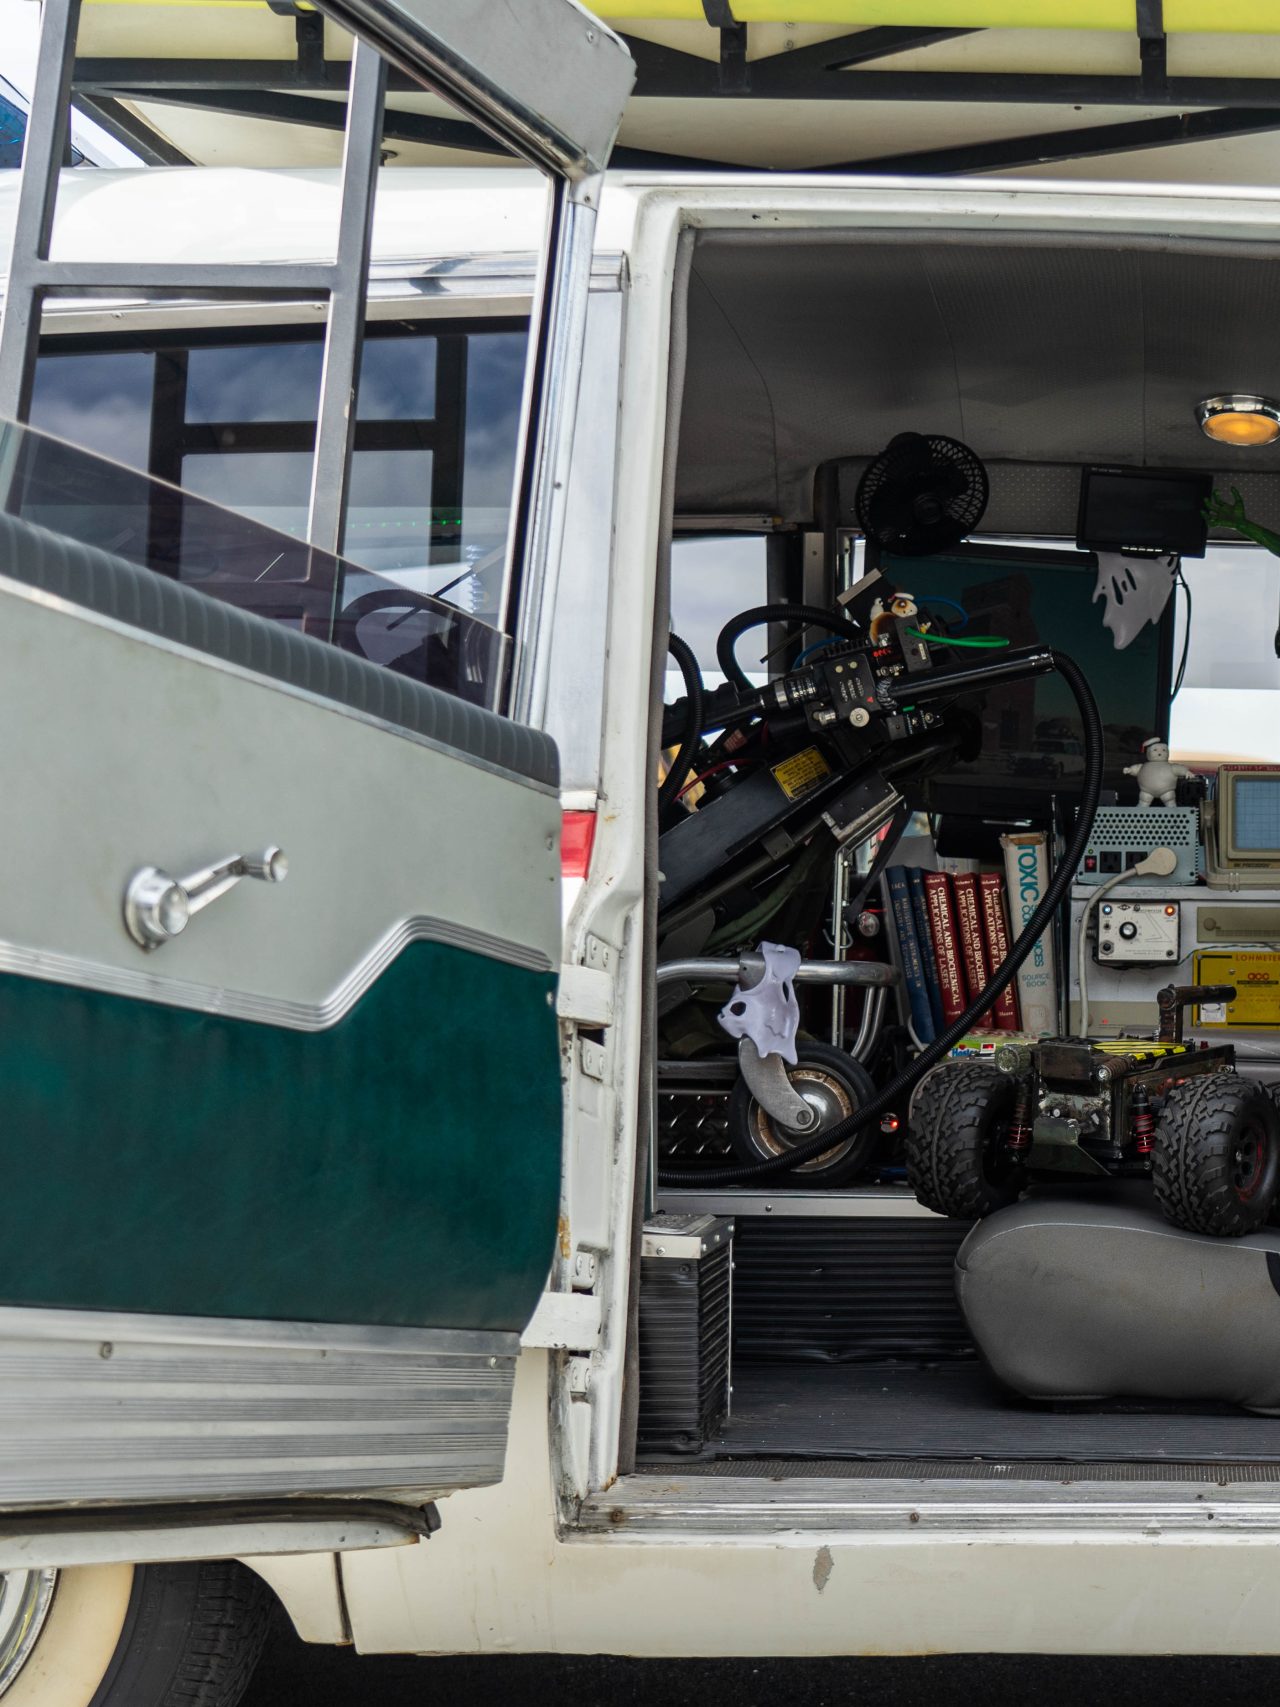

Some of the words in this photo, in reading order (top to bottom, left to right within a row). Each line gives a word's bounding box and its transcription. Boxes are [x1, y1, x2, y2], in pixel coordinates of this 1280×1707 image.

[1017, 845, 1040, 902] TOXIC
[929, 890, 944, 944] APPLICATIONS
[938, 887, 950, 931] CHEMICAL
[958, 890, 972, 944] APPLICATIONS
[966, 888, 978, 930] CHEMICAL
[984, 889, 997, 943] APPLICATIONS
[992, 946, 1000, 956] OF
[992, 888, 1004, 928] CHEMICAL
[998, 932, 1007, 949] AND
[937, 947, 946, 957] OF
[944, 932, 953, 948] AND
[965, 946, 974, 958] OF
[972, 932, 981, 950] AND
[939, 960, 950, 988] LASERS
[946, 950, 961, 1005] BIOCHEMICAL
[967, 960, 978, 989] LASERS
[974, 952, 986, 992] BIOCHEM
[1022, 973, 1050, 981] SOURCE
[1026, 980, 1046, 988] BOOK
